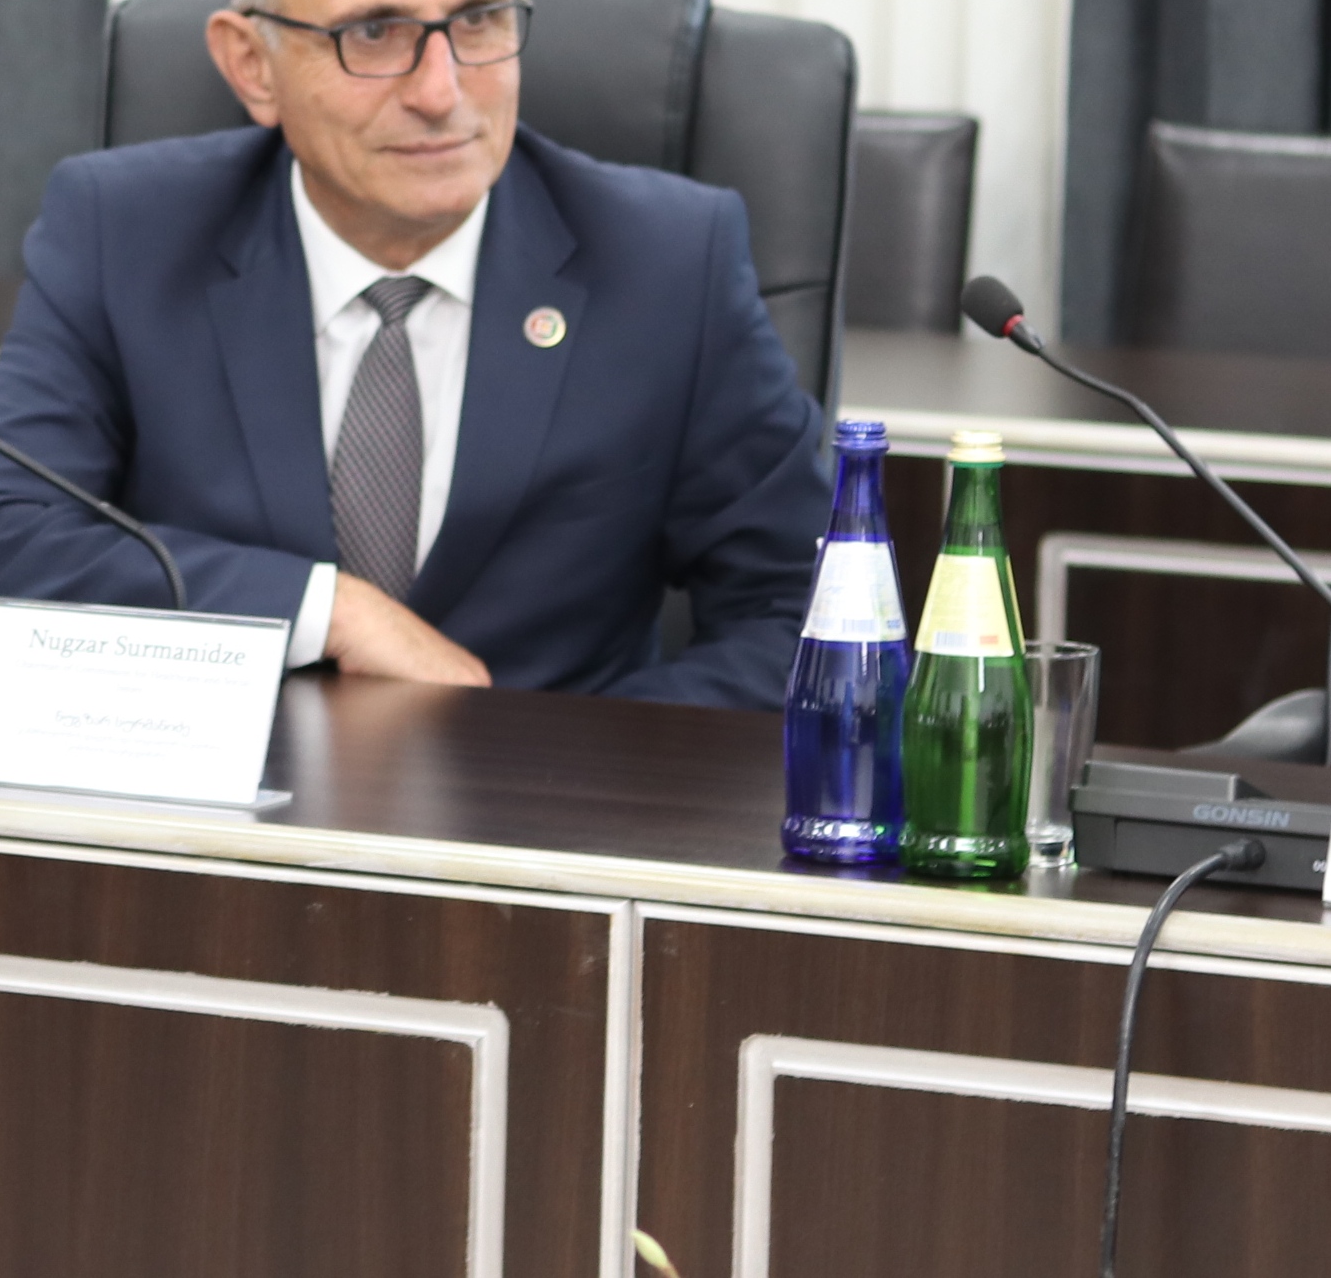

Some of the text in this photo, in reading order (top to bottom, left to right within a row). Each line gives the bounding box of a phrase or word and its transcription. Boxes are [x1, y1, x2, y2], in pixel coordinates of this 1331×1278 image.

[29, 628, 247, 666] Nugzar Surmanidze
[1192, 804, 1291, 828] GONSIN
